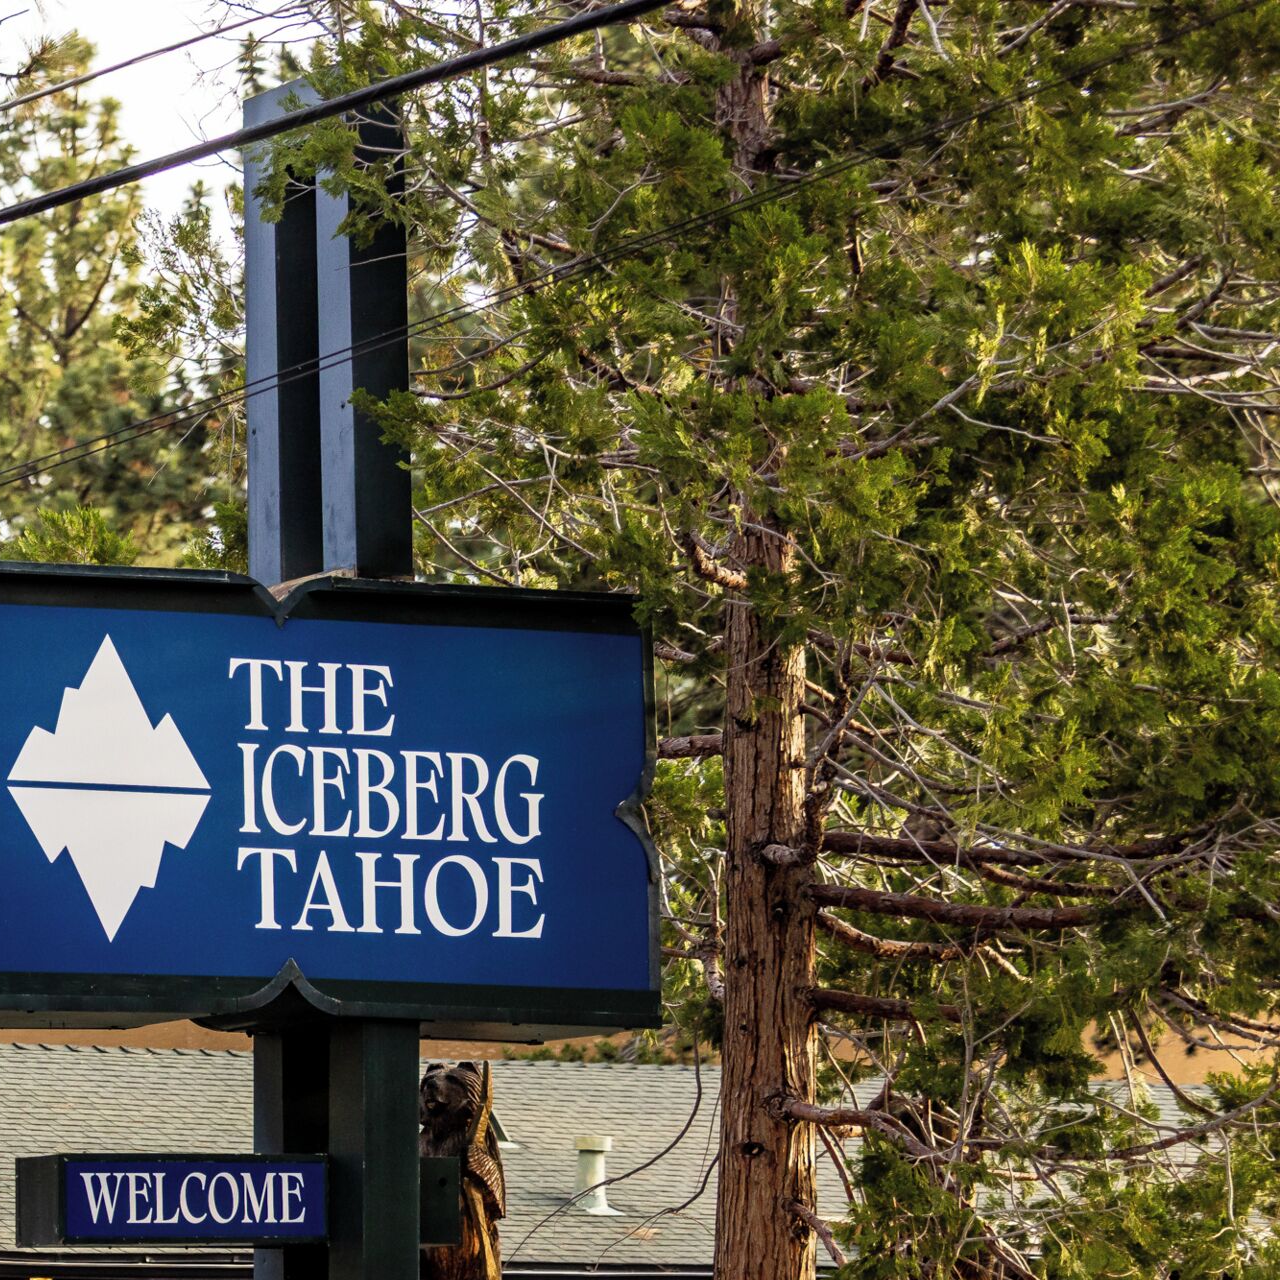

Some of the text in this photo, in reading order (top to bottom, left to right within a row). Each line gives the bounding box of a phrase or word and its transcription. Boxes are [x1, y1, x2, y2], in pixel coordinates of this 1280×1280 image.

[229, 657, 396, 737] THE
[238, 742, 545, 845] ICEBERG
[236, 847, 546, 939] TAHOE
[80, 1172, 306, 1224] WELCOME
